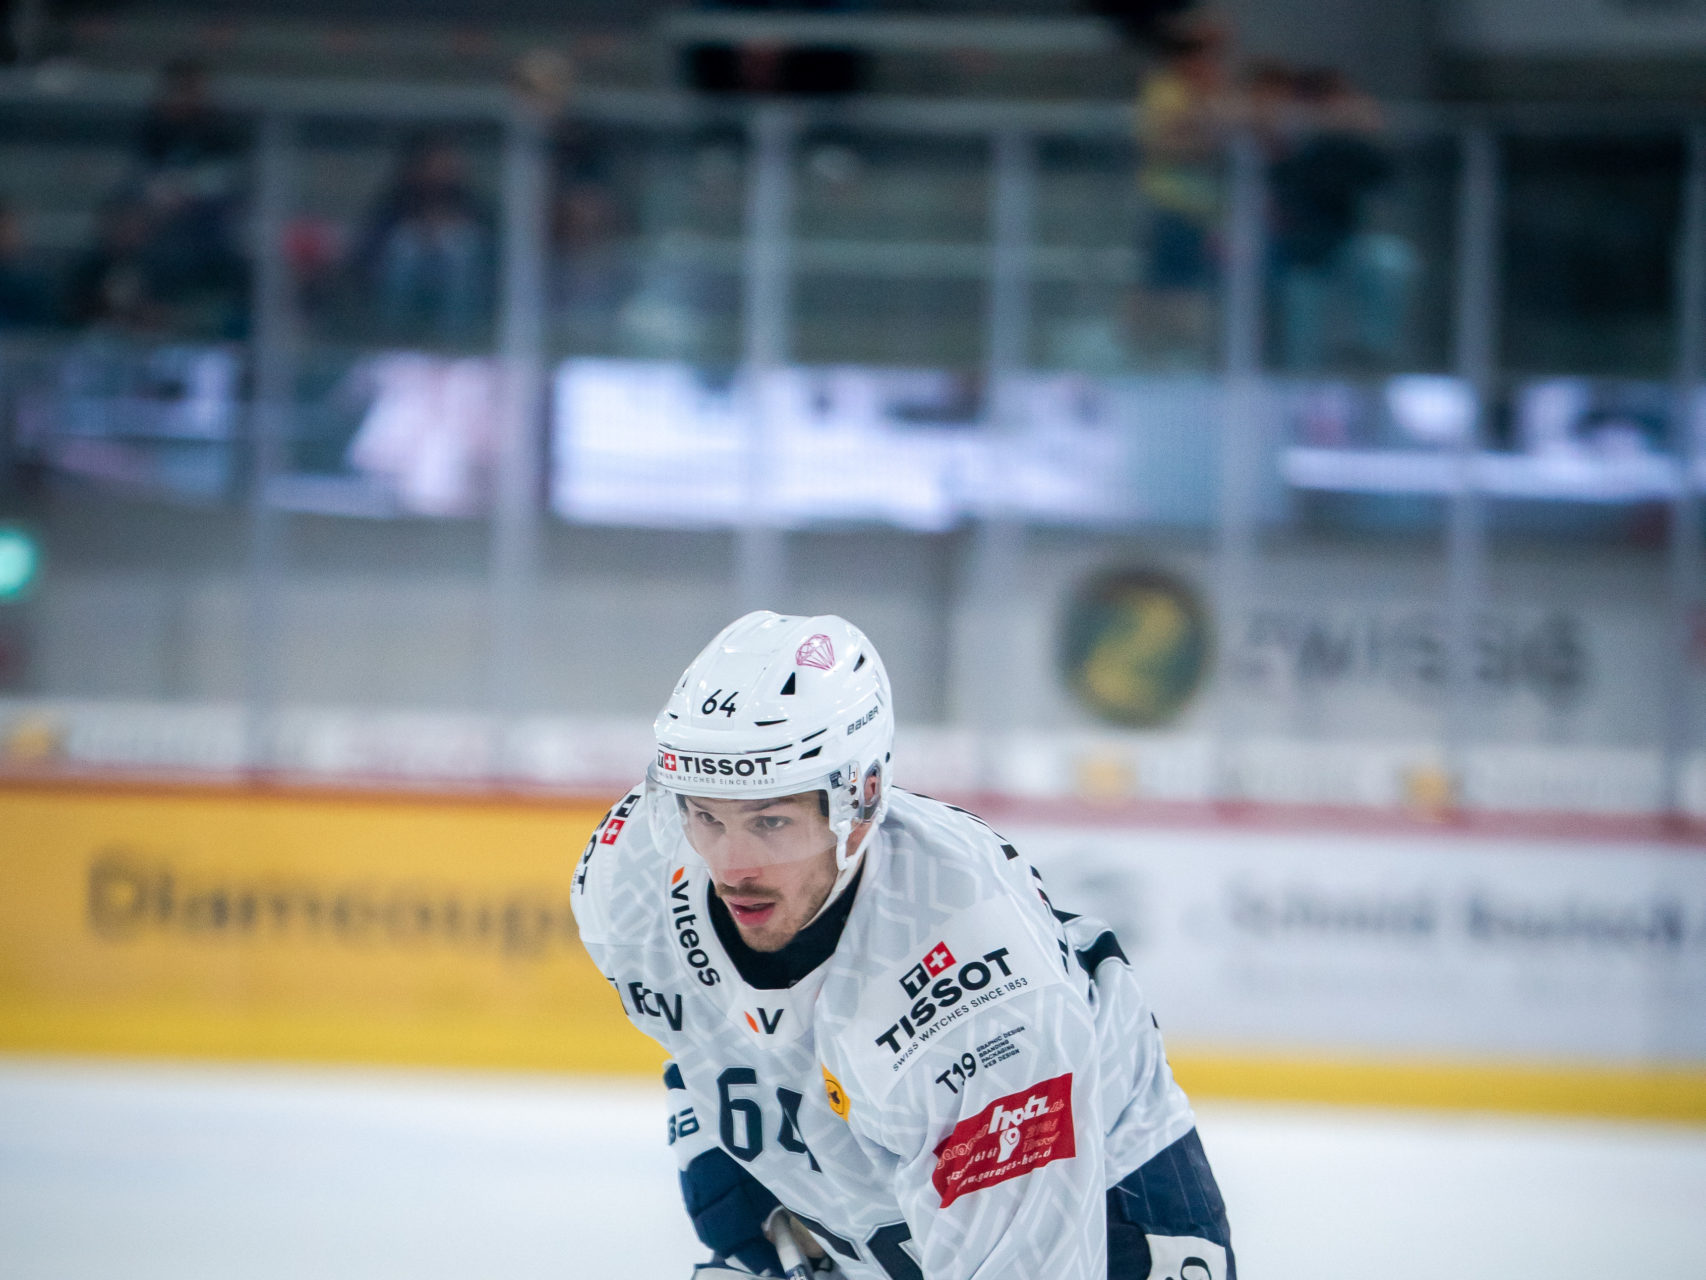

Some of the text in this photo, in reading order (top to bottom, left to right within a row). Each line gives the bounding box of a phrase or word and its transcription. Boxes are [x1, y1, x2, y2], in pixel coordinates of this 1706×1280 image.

[701, 689, 739, 718] 64
[678, 756, 772, 776] TISSOT
[875, 947, 1013, 1054] TISSOT
[892, 977, 1029, 1072] SWISS WATCHES SINCE 1853
[935, 1052, 976, 1094] T19
[988, 1095, 1050, 1134] hotz
